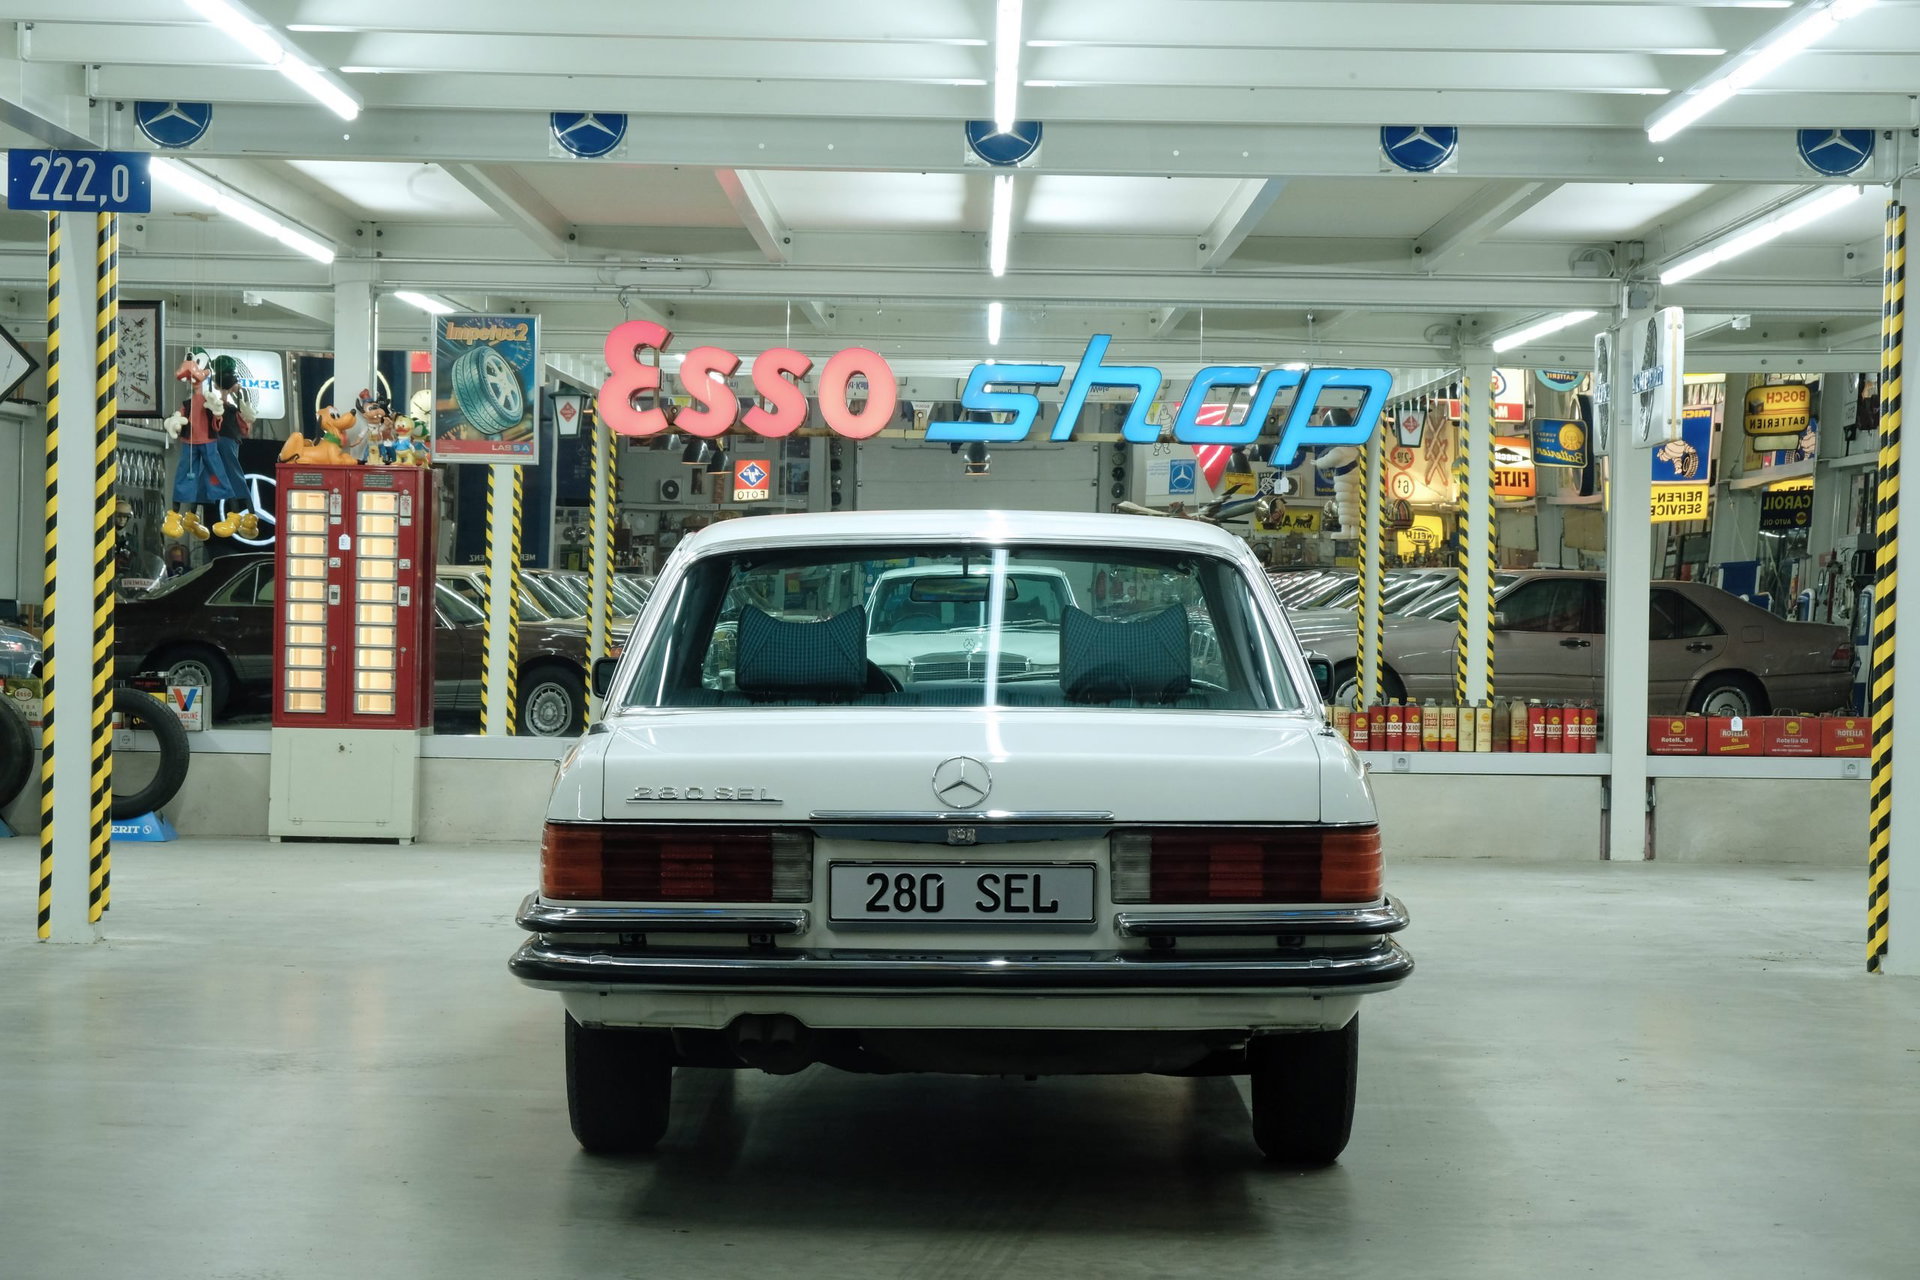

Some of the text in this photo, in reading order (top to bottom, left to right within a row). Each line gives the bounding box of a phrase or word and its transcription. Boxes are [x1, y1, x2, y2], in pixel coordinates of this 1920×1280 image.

[30, 156, 129, 207] 222,0
[924, 334, 1392, 467] shop
[634, 787, 777, 800] 280 SEL
[111, 825, 140, 833] ERIT
[866, 873, 1059, 913] 280 SEL
